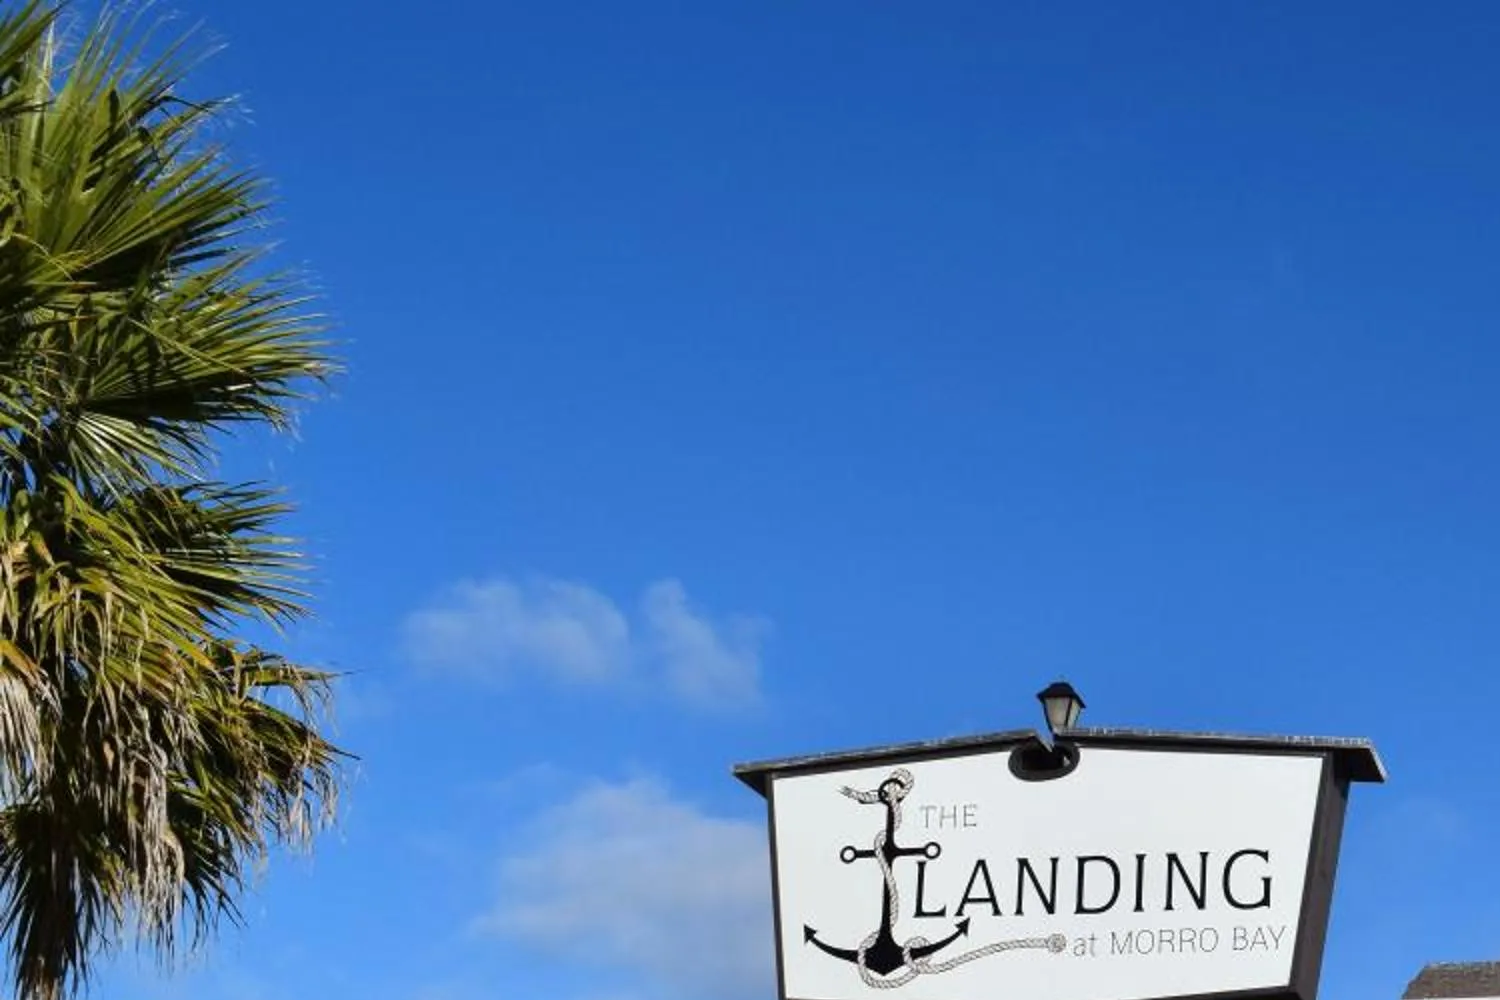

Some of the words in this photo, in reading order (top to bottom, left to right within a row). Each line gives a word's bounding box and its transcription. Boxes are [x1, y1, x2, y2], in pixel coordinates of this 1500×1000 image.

[919, 803, 978, 830] THE
[912, 848, 1273, 918] LANDING
[1072, 933, 1098, 958] at
[1110, 927, 1220, 956] MORRO
[1232, 925, 1287, 952] BAY
